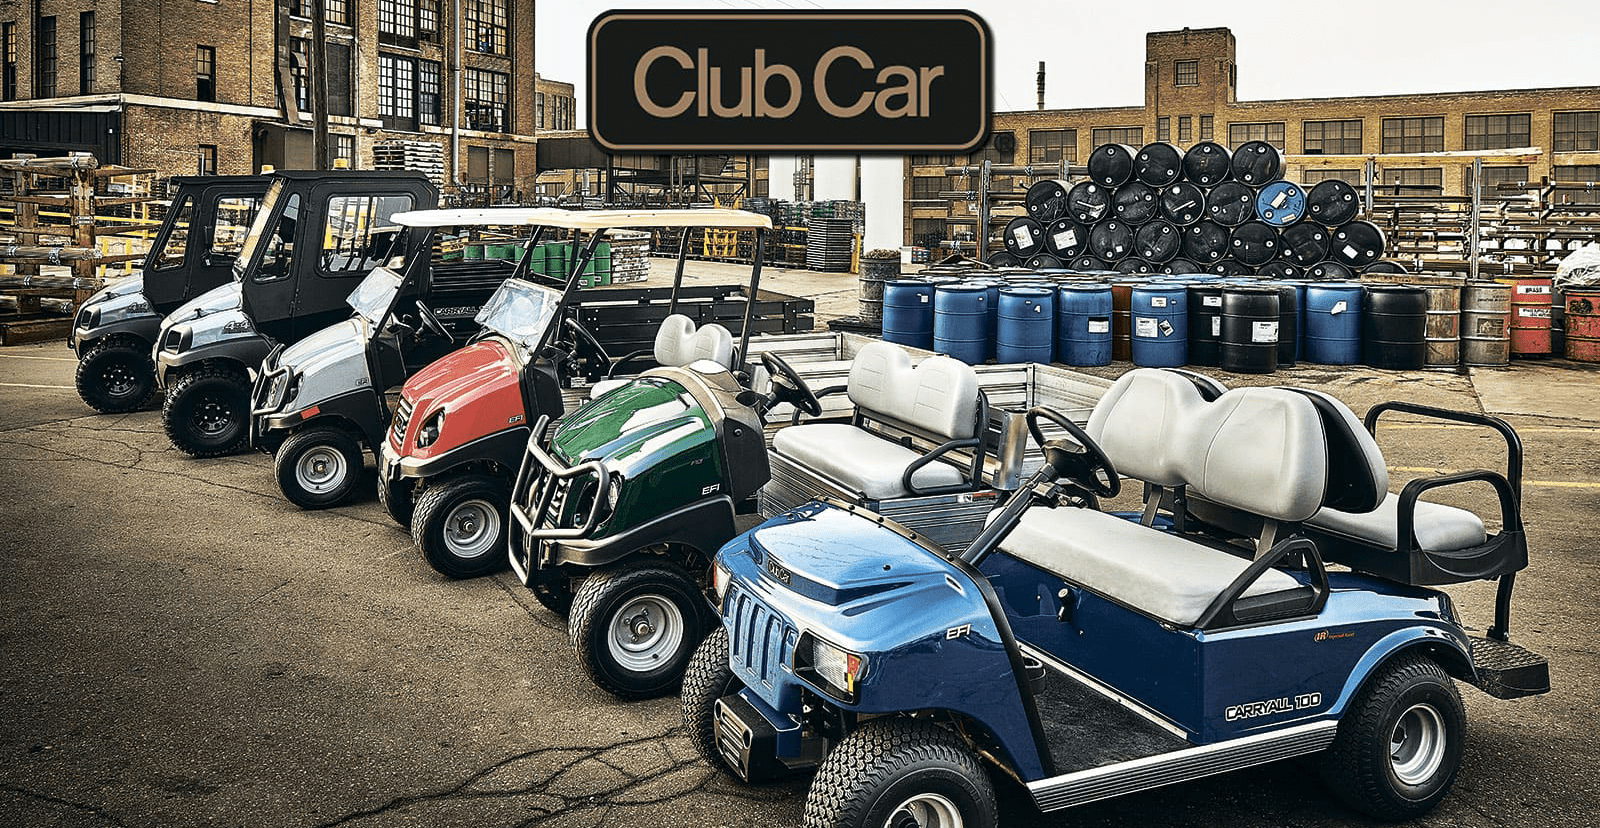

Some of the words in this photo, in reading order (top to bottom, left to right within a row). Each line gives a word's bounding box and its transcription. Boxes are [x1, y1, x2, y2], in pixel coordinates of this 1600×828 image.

[433, 306, 478, 316] CARRYALL
[702, 483, 720, 495] EFI
[946, 623, 971, 640] EFI
[1225, 697, 1293, 721] CARRYALL
[1295, 692, 1321, 710] 100
